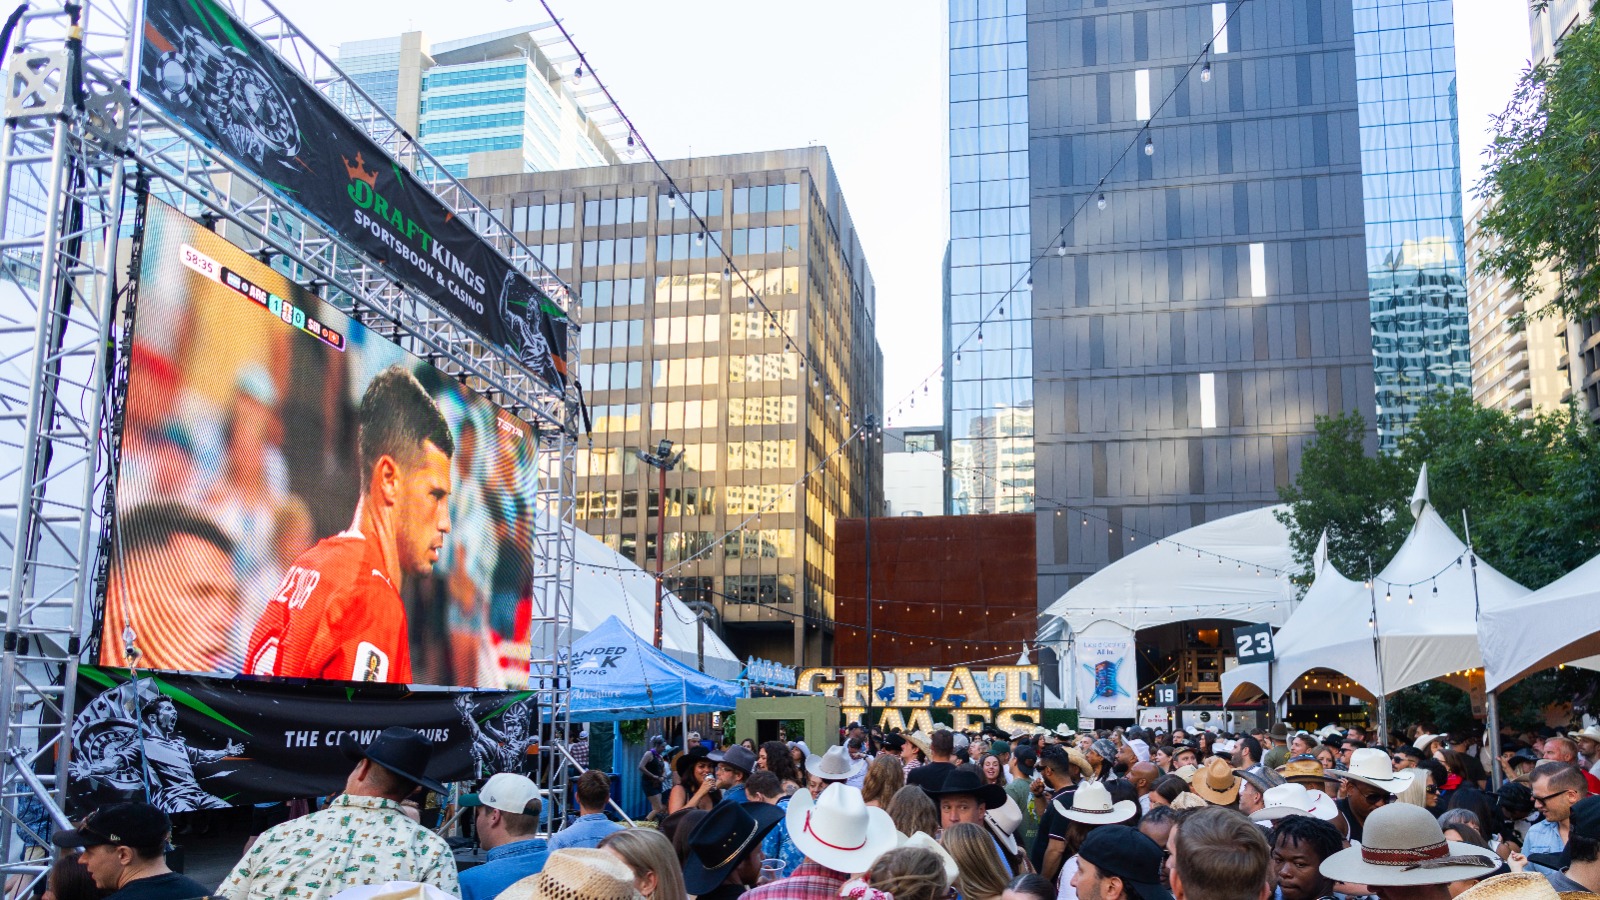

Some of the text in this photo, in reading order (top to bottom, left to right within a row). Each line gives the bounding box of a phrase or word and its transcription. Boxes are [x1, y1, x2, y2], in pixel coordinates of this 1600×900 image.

[347, 178, 486, 295] DRAFTKINGS
[185, 250, 213, 274] 58:35
[249, 286, 267, 305] ARG
[354, 210, 485, 316] SPORTSBOOK & CASINO
[1236, 632, 1273, 657] 23
[797, 665, 1041, 707] GREAT
[1158, 688, 1174, 703] 19
[284, 730, 320, 748] THE
[410, 728, 450, 742] OURS
[842, 707, 1041, 738] IMES
